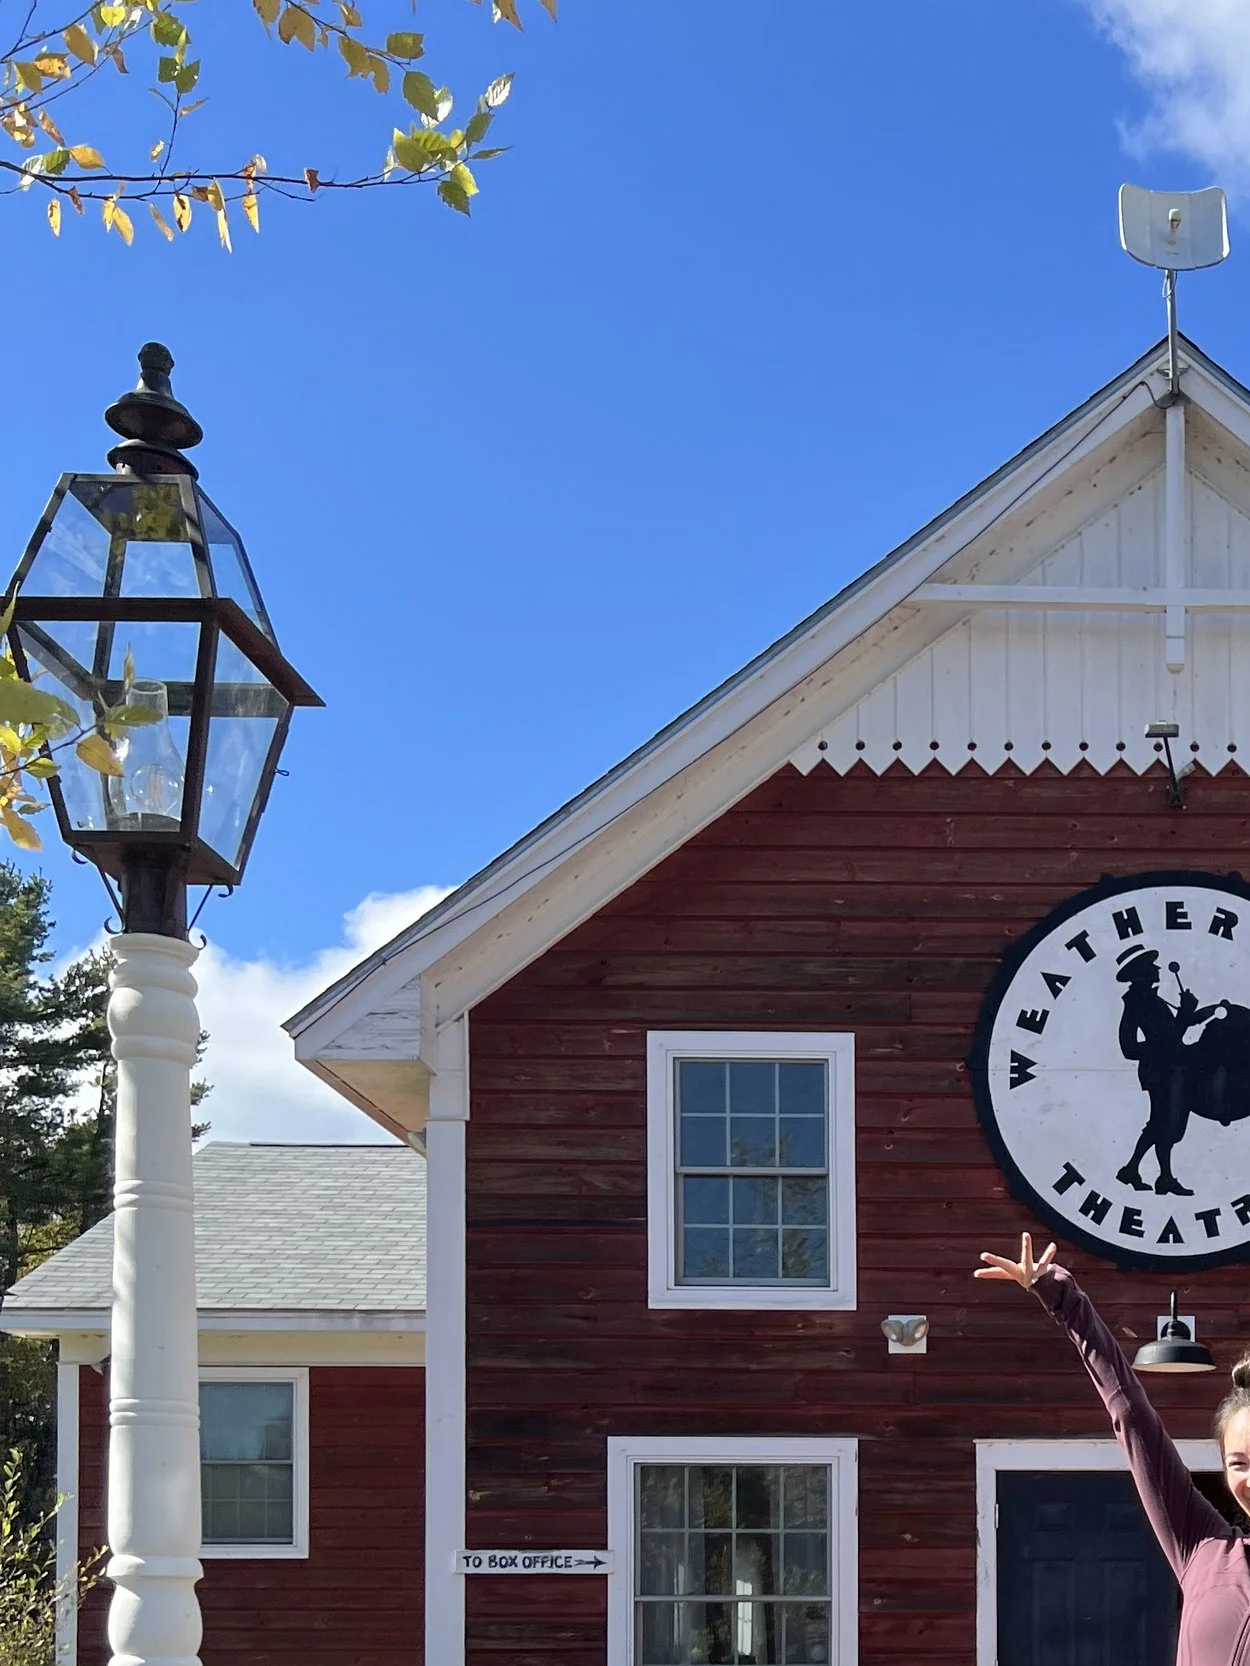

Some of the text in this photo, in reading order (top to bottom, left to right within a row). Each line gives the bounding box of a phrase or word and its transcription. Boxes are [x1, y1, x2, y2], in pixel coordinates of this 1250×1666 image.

[462, 1554, 573, 1569] TO BOX OFFICE
